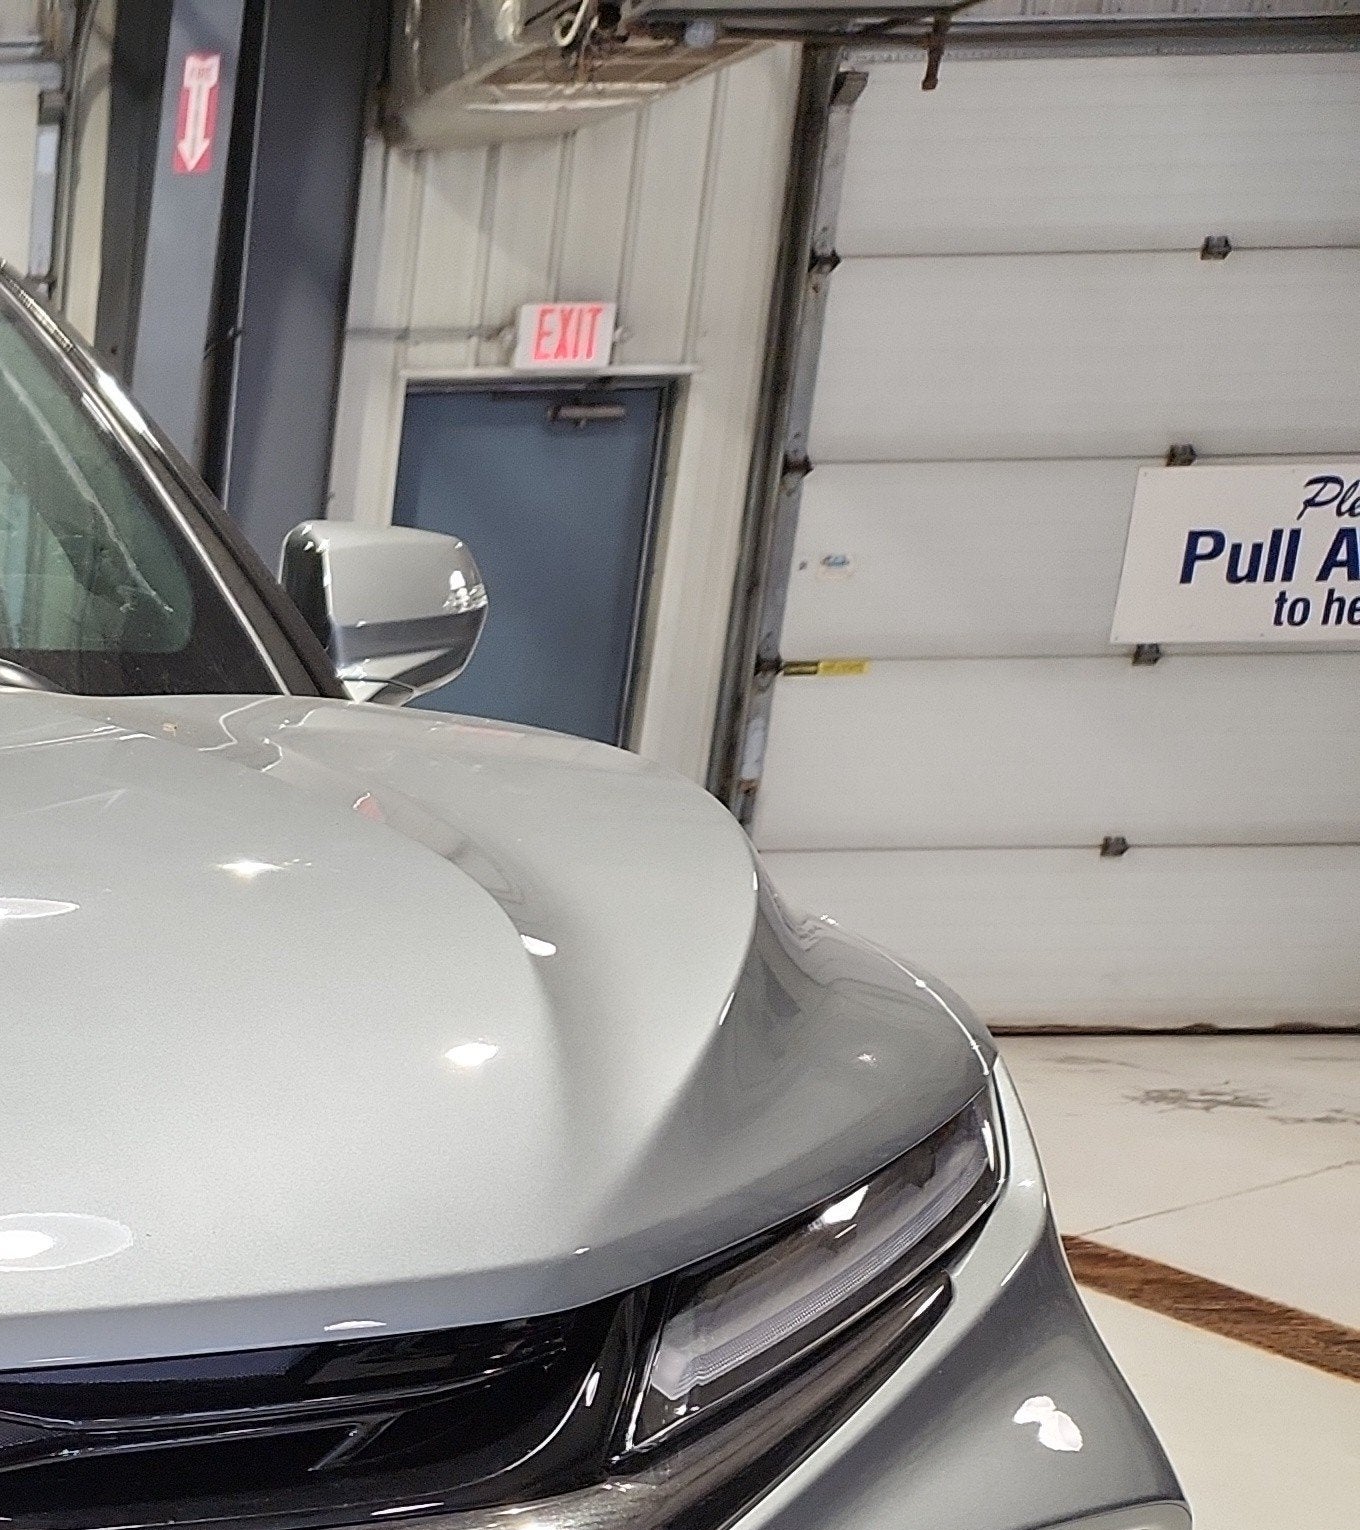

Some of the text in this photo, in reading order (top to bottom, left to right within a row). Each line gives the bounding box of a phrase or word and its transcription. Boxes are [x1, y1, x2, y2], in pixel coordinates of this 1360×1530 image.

[533, 307, 604, 360] EXIT
[1179, 526, 1360, 584] Pull A
[1273, 590, 1311, 627] to
